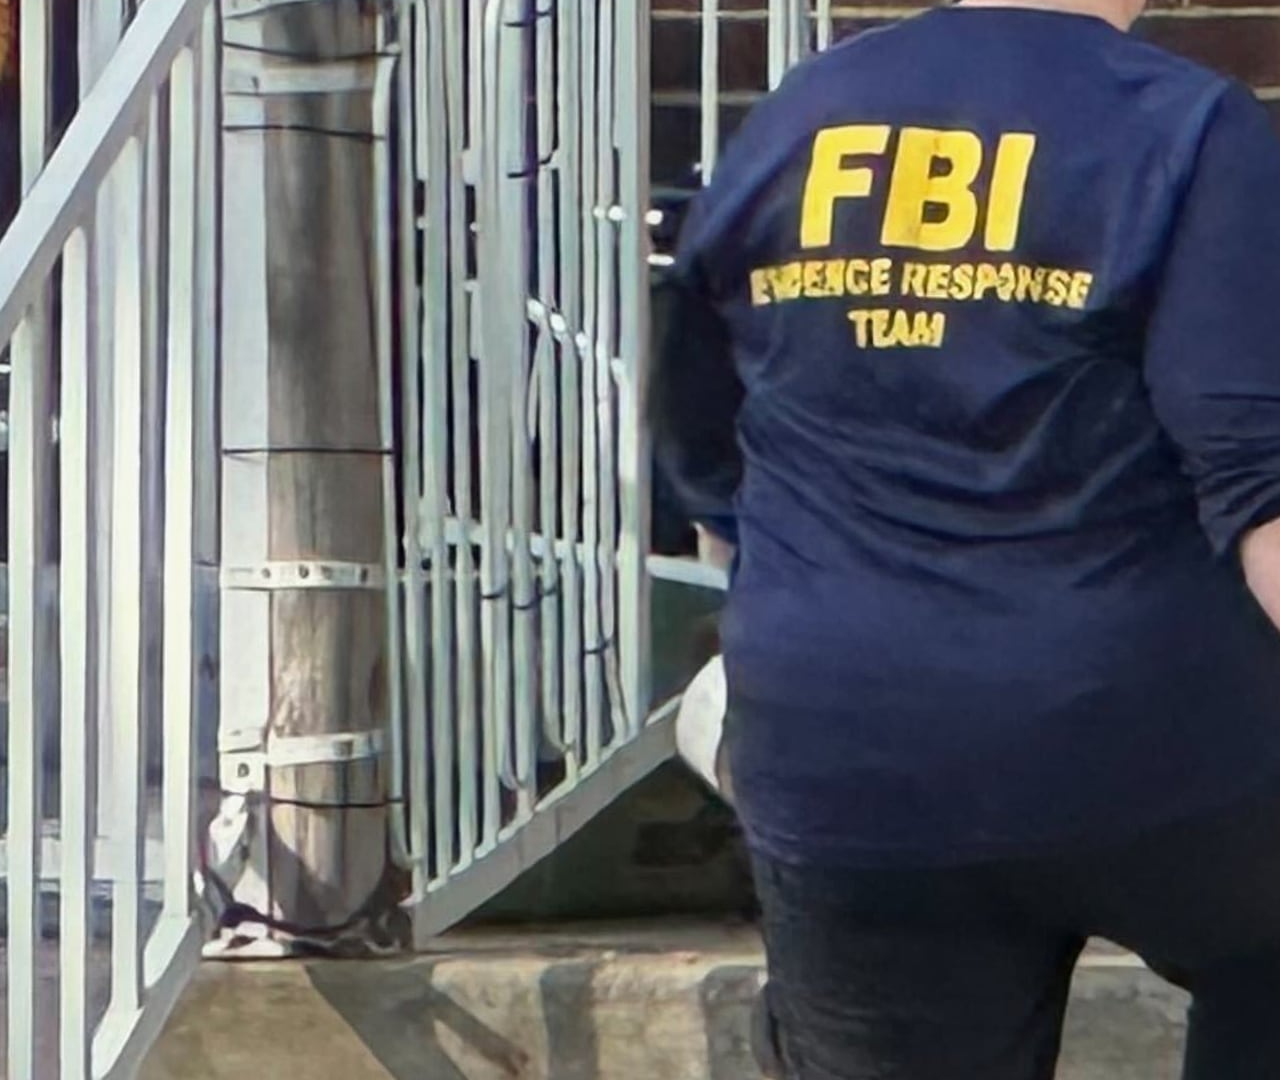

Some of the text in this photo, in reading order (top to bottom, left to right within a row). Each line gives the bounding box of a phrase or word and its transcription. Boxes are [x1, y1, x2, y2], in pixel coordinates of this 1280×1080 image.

[800, 125, 1036, 252] FBI
[901, 262, 1093, 309] RESPONSE
[847, 309, 946, 348] TEAM
